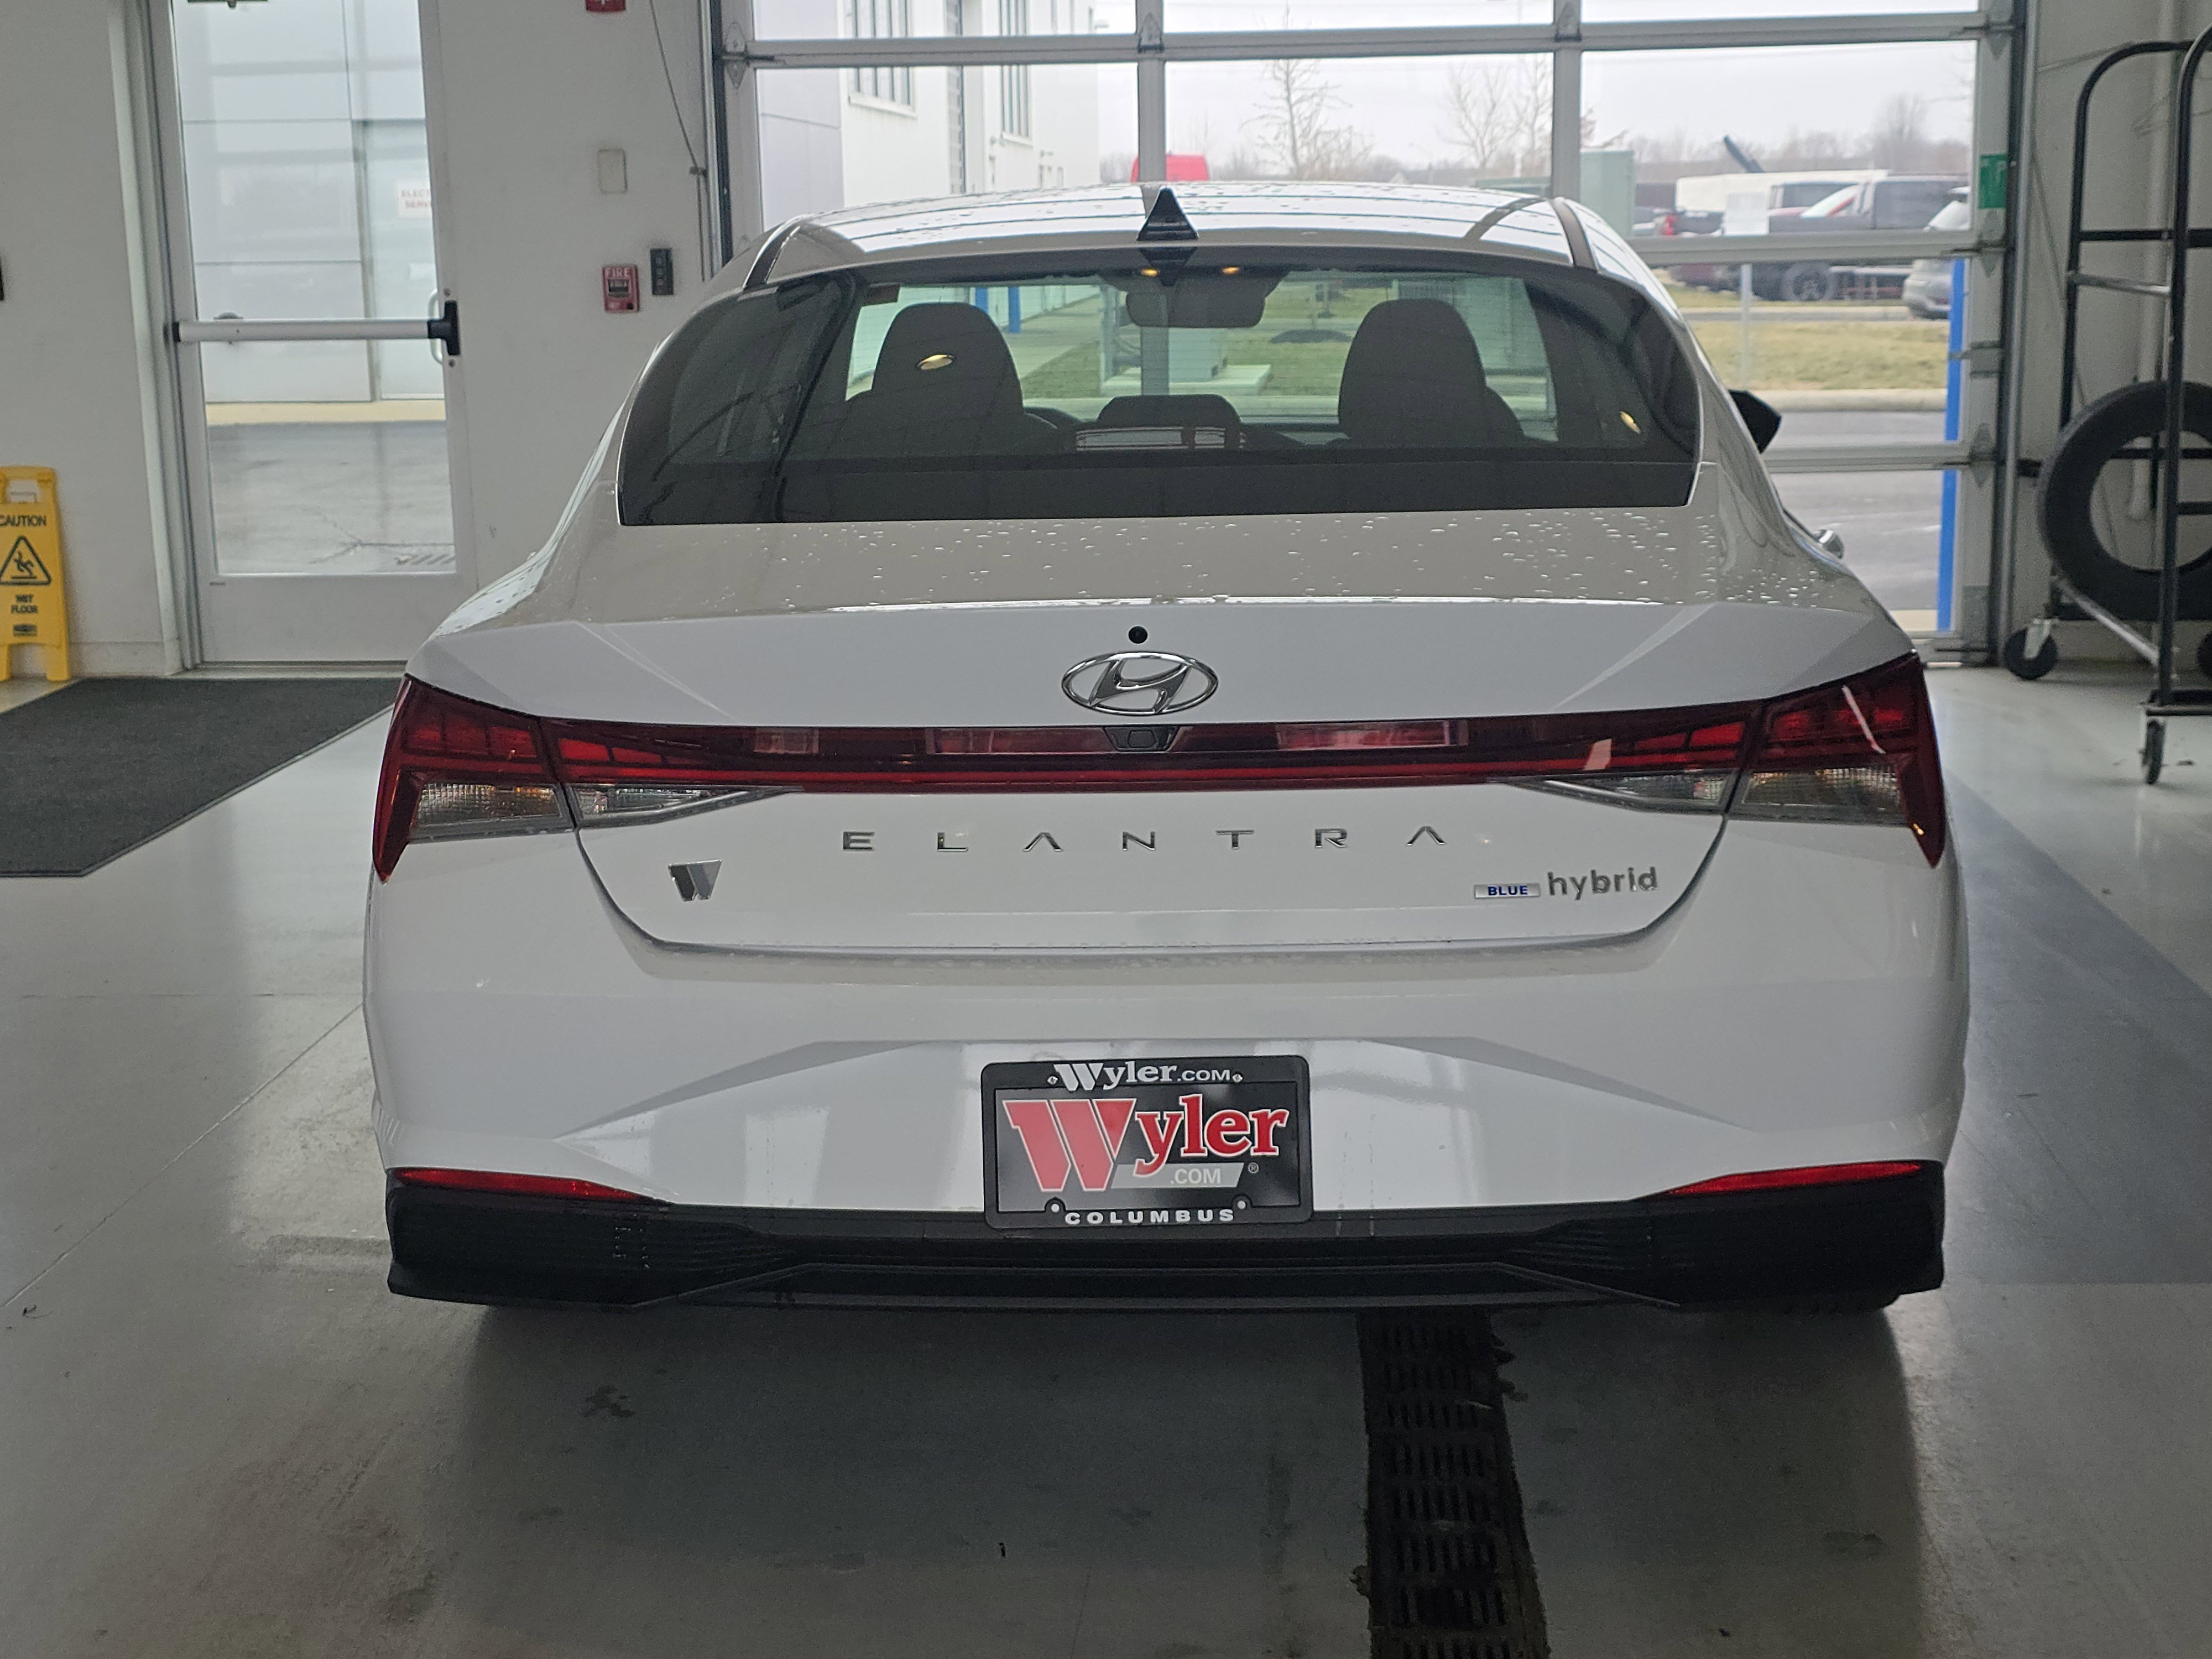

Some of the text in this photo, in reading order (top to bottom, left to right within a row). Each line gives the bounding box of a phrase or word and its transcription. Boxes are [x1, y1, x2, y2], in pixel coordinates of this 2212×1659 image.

[604, 267, 630, 276] FIRE
[0, 514, 46, 526] CAUTION
[15, 594, 34, 602] WET
[11, 604, 38, 614] FLOOR
[842, 826, 1446, 853] ELANTRA
[1488, 866, 1658, 900] BLUE hybrid
[1002, 1093, 1290, 1192] Wyler
[1170, 1167, 1222, 1185] .COM
[1065, 1208, 1234, 1225] COLUMBUS
